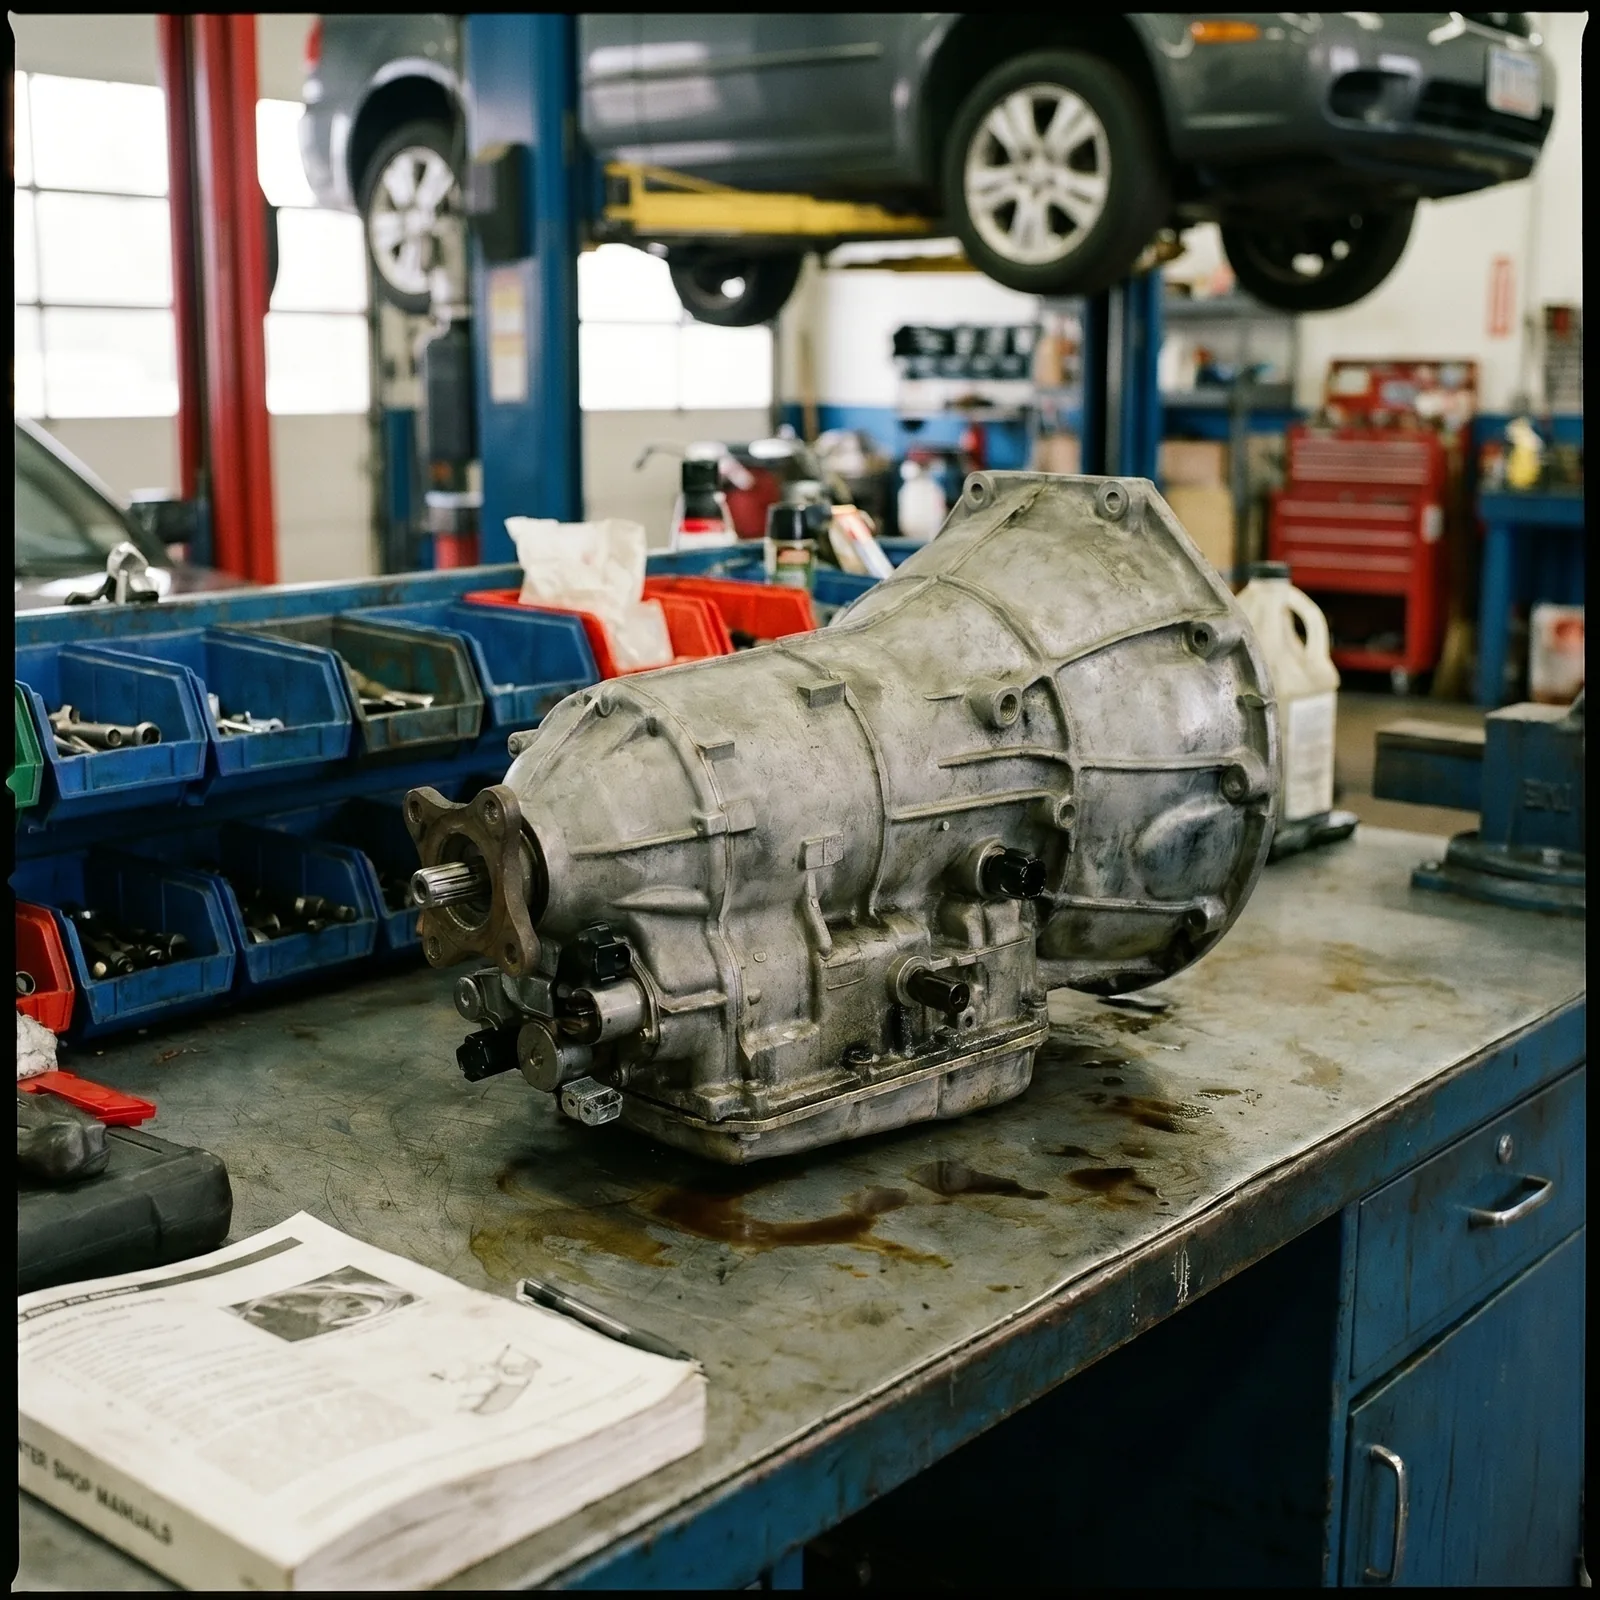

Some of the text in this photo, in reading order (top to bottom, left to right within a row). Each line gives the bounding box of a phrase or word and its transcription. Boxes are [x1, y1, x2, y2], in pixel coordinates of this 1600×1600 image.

[18, 1438, 173, 1545] TER SHOP MANUALS
